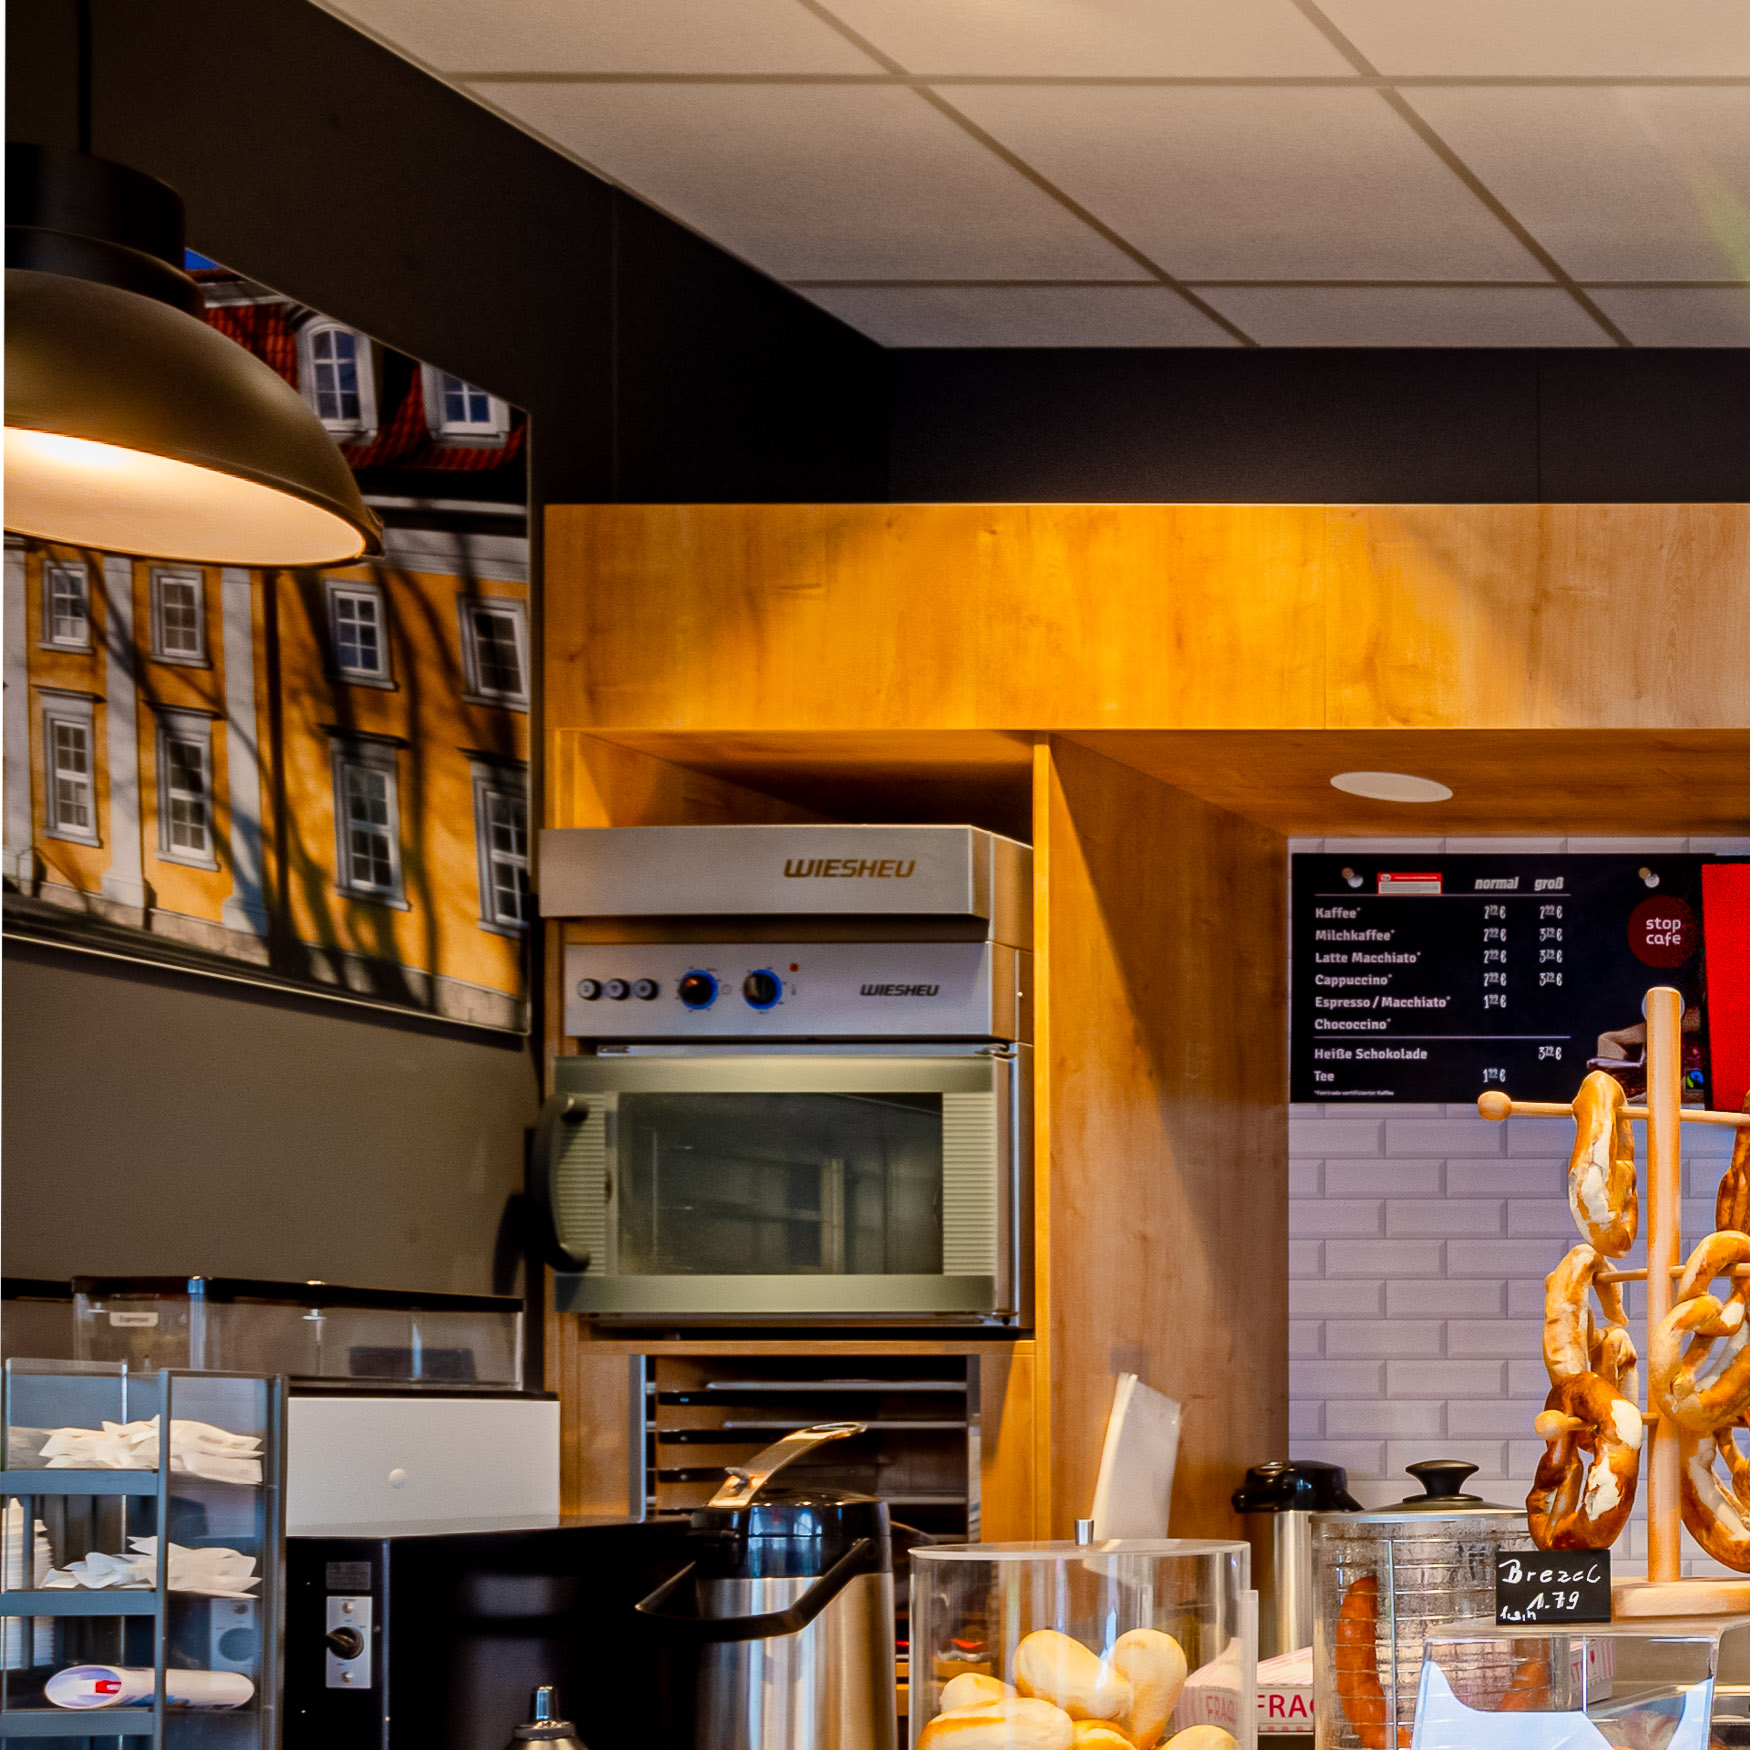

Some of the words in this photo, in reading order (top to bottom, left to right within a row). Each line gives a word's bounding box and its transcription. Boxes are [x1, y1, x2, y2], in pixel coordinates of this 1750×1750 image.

[784, 859, 916, 878] WIESHEU
[1474, 877, 1519, 890] normal
[1534, 877, 1563, 891] groß
[1645, 918, 1681, 933] stop
[1315, 952, 1348, 963] Latte
[861, 984, 939, 997] WIESHEU
[1315, 996, 1370, 1010] Espresso
[1314, 1049, 1352, 1060] Heiße
[1355, 1049, 1428, 1060] Schokolade
[1314, 1071, 1335, 1082] Tee
